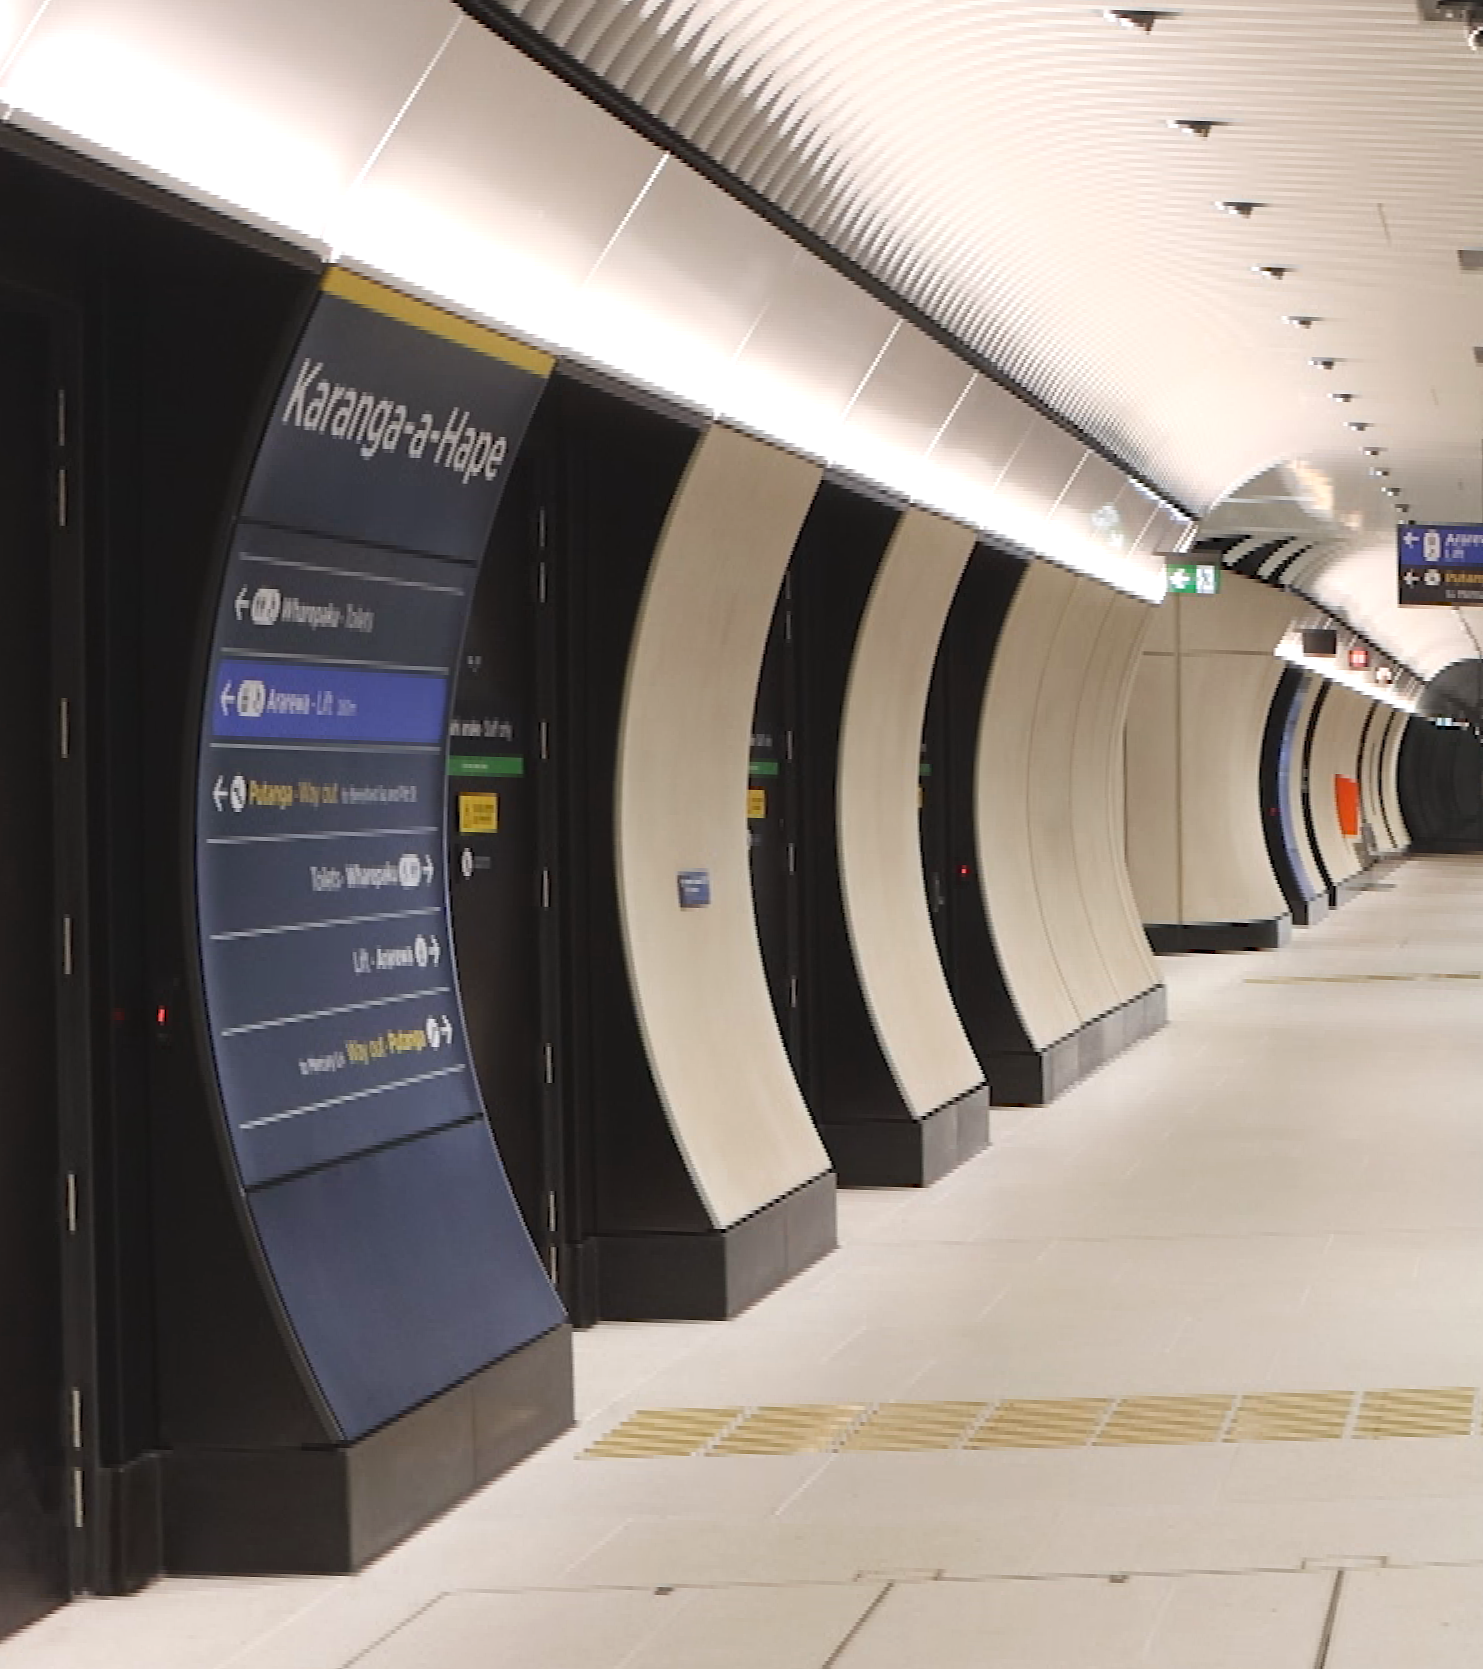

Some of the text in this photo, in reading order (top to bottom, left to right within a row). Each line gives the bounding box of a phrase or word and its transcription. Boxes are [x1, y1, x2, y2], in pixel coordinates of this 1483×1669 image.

[282, 358, 508, 486] Karanga-a-Hape
[266, 688, 311, 715] Ararewa
[249, 780, 293, 810] Putanga
